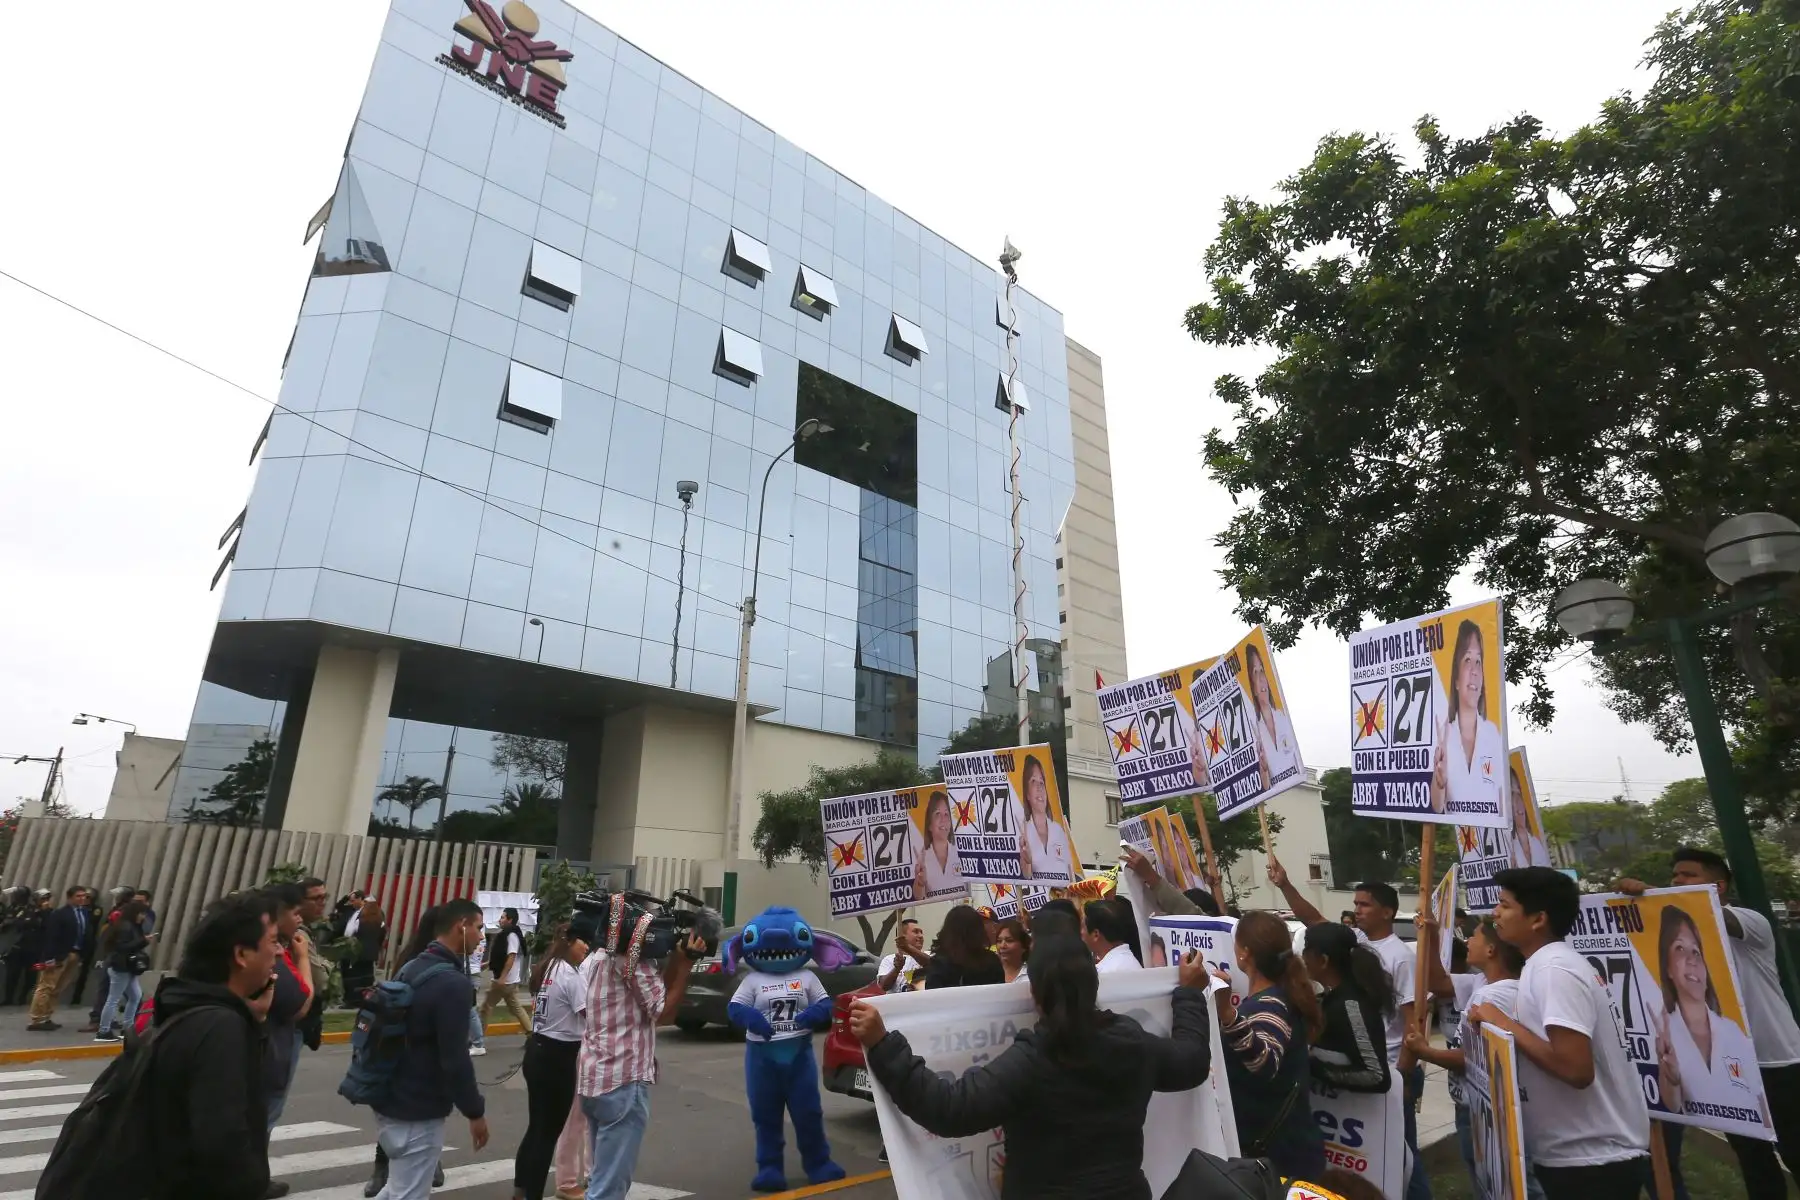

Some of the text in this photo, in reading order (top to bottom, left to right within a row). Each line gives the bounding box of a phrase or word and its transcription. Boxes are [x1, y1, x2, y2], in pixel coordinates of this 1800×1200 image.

[451, 40, 559, 112] JNE
[1353, 618, 1444, 669] UNIÓN POR EL PERÚ
[1207, 670, 1221, 694] POR
[1218, 665, 1227, 685] EL
[1354, 669, 1375, 680] MARCA
[1391, 659, 1419, 673] ESCRIBE
[1099, 670, 1182, 711] UNIÓN POR EL PERÚ
[1103, 709, 1124, 718] MARCA
[1137, 696, 1163, 709] ESCRIBE
[1394, 676, 1431, 744] 27
[1144, 706, 1177, 752] 27
[1223, 694, 1248, 752] 27
[943, 750, 1015, 777] UNIÓN POR EL PERÚ
[1118, 750, 1187, 776] CON EL PUEBLO
[1212, 746, 1256, 783] CON EL PUEBLO
[1355, 748, 1429, 771] CON EL PUEBLO
[1120, 769, 1194, 799] ABBY YATACO
[1216, 771, 1262, 808] ABBY YATACO
[1352, 781, 1430, 808] ABBY YATACO
[824, 788, 918, 821] UNIÓN POR EL PERÚ
[982, 788, 1009, 833] 27
[1446, 801, 1499, 814] CONGRESISTA
[826, 820, 850, 829] MARCA
[867, 813, 896, 824] ESCRIBE
[872, 824, 908, 867] 27
[957, 836, 1017, 851] CON EL PUEBLO
[832, 867, 911, 890] CON EL PUEBLO
[960, 858, 1021, 876] ABBY YATACO
[1033, 872, 1069, 880] CONGRESISTA
[1464, 864, 1477, 879] CON
[1477, 862, 1485, 878] EL
[831, 885, 913, 912] ABBY YATACO
[926, 886, 966, 898] CONGRESISTA
[1468, 885, 1502, 906] ABBY YAT
[997, 905, 1012, 917] CON
[1024, 895, 1047, 911] UEBLO
[1571, 908, 1587, 936] OR
[1586, 907, 1604, 935] EL
[1171, 931, 1213, 949] Dr. Alexis
[1573, 935, 1630, 950] ESCRIBE ASÍ
[772, 1000, 796, 1021] 27
[1685, 1100, 1762, 1123] CONGRESISTA
[1324, 1149, 1368, 1172] RESO
